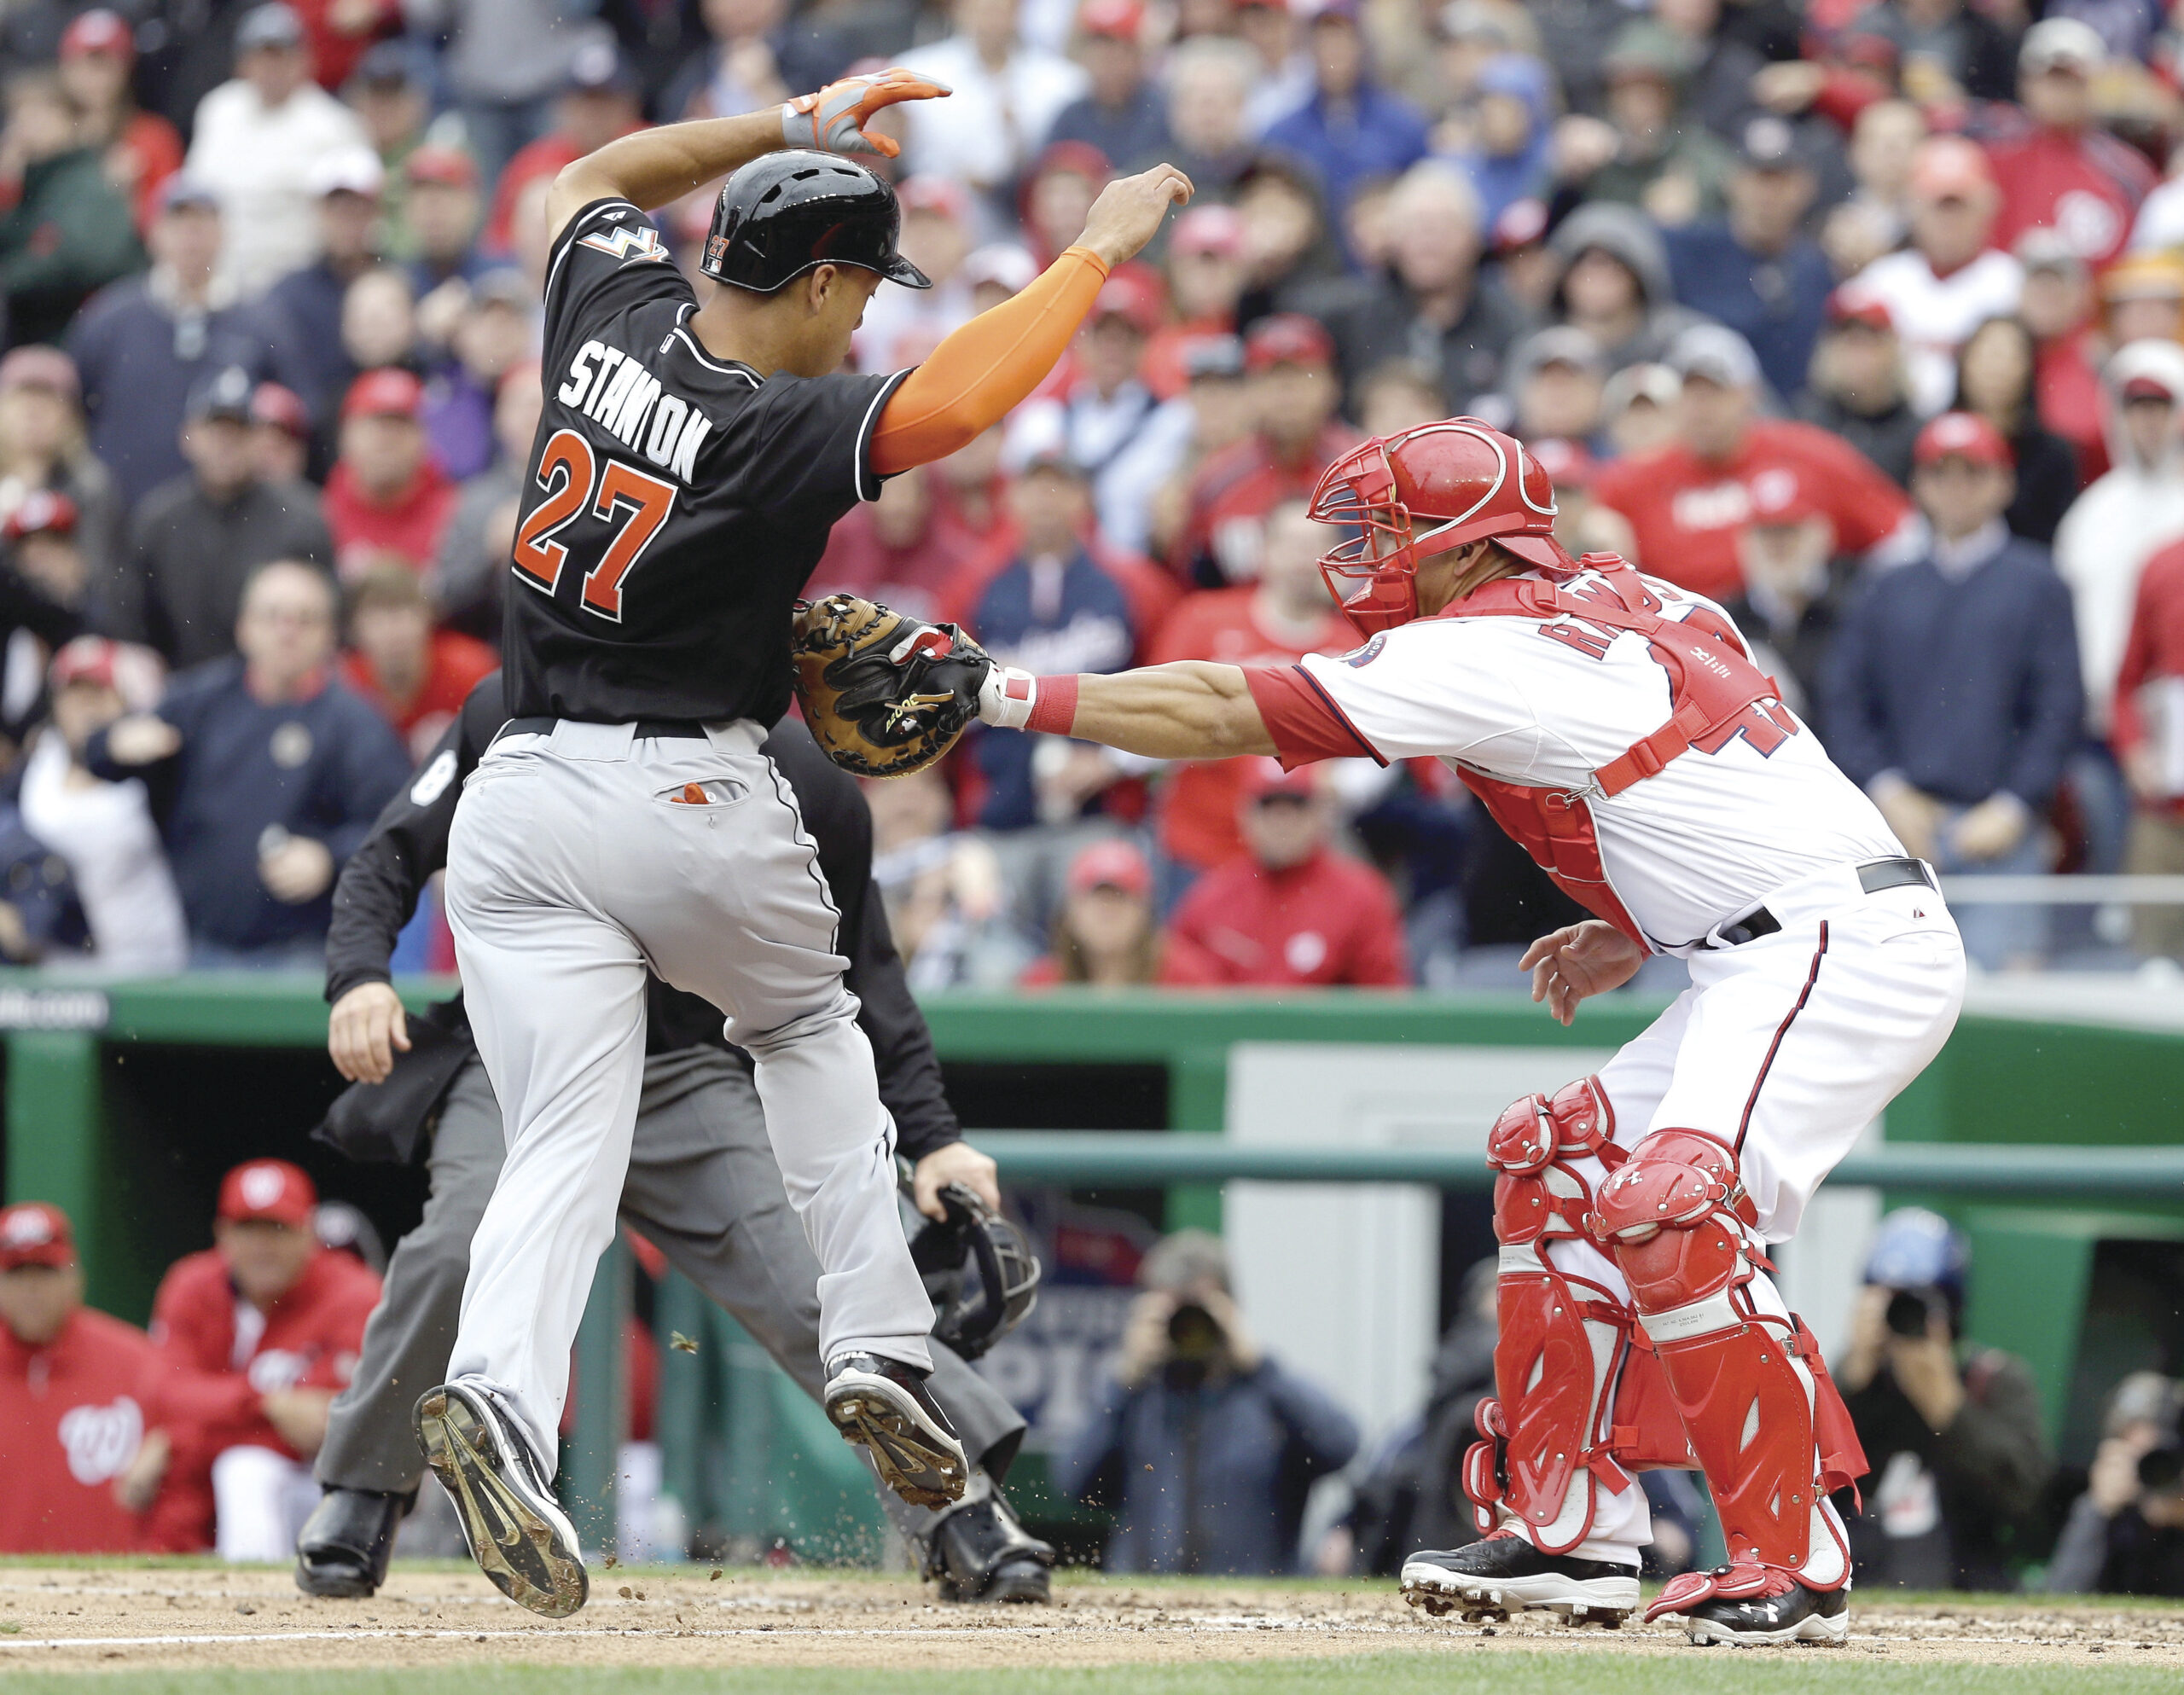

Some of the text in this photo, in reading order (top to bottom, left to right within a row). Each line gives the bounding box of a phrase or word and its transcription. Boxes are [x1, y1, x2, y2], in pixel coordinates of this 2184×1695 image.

[709, 235, 730, 259] 27
[558, 340, 713, 485] STANTON
[512, 428, 679, 624] 27
[410, 749, 458, 807] 8
